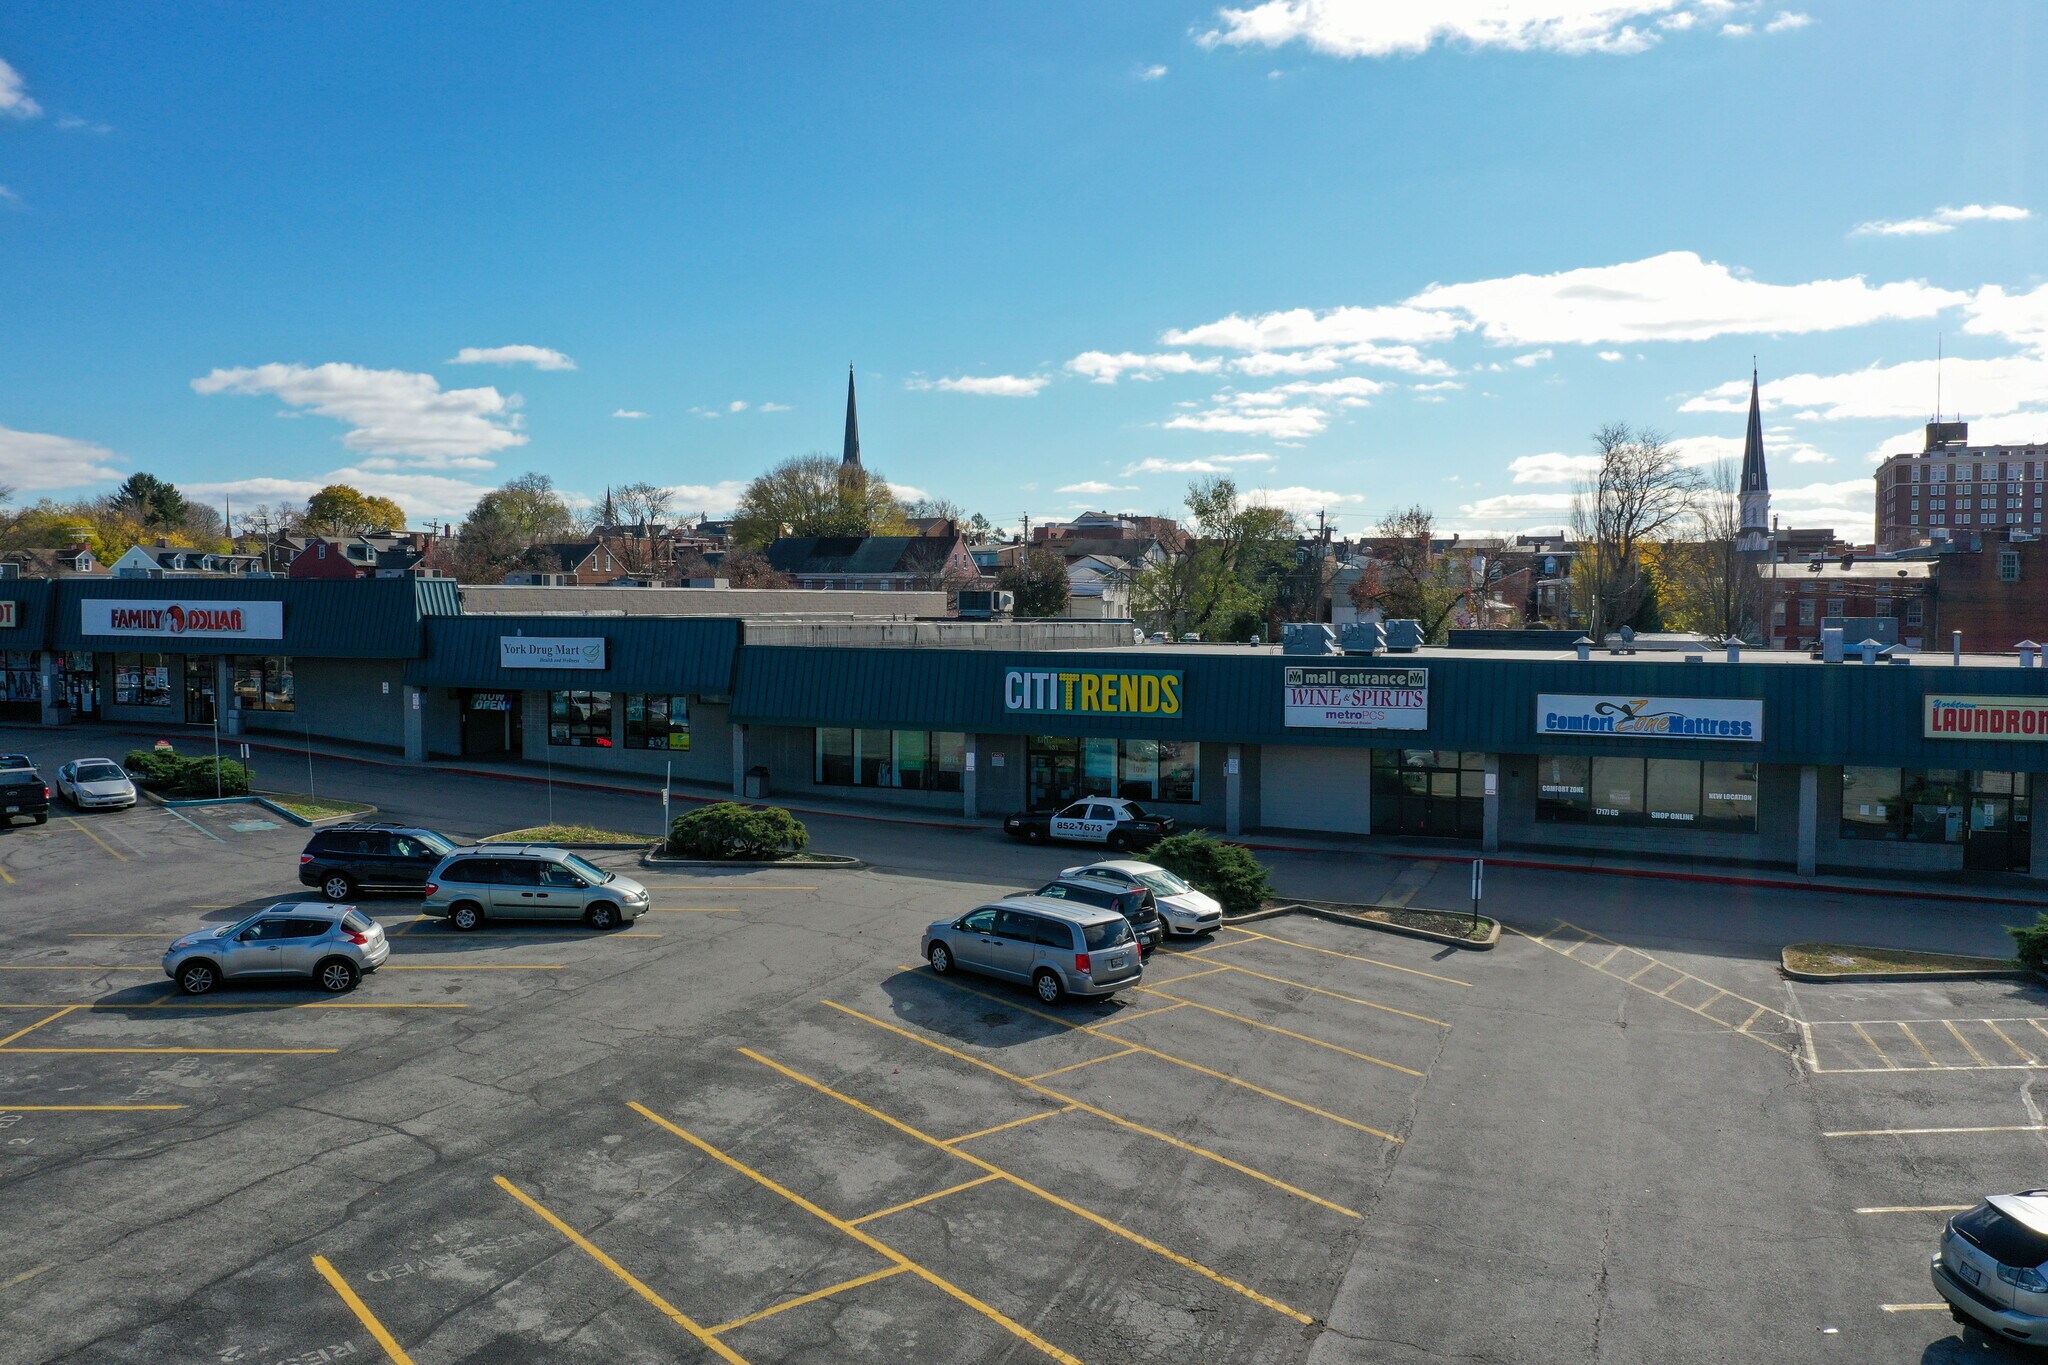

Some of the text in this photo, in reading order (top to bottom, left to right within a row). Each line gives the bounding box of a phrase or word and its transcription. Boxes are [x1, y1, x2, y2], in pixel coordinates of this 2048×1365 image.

[111, 609, 243, 631] FAMILY DOLLAR
[504, 644, 580, 657] York Drug Mart
[1305, 670, 1336, 684] mall
[1339, 671, 1407, 685] entrance
[478, 693, 505, 701] NOW
[1291, 688, 1424, 708] WINE & SPIRITS
[475, 700, 506, 711] OPEN
[1932, 699, 1978, 711] Yorktown
[1326, 710, 1385, 720] metroPCS
[1546, 712, 1614, 732] Comfort
[1669, 715, 1752, 736] Mattress
[1542, 785, 1584, 794] COMFORT ZONE
[1708, 792, 1752, 801] NEW LOCATION
[1651, 811, 1694, 821] SHOP ONLINE
[1056, 821, 1103, 832] 852-7673
